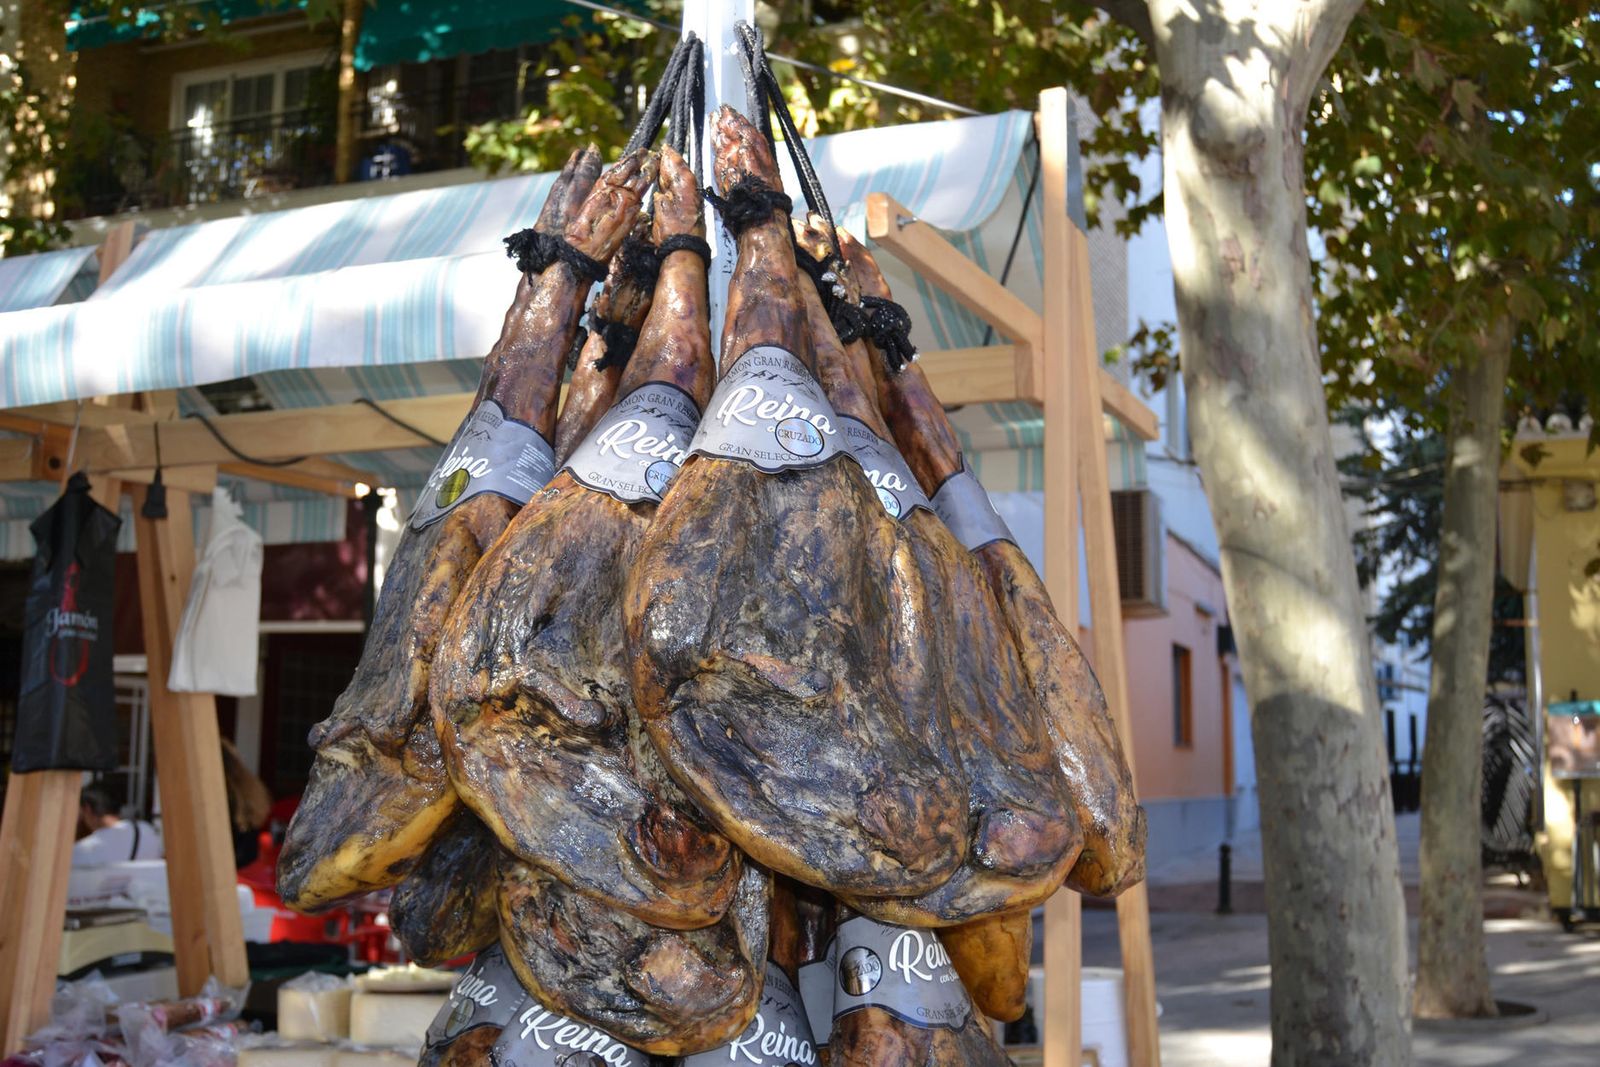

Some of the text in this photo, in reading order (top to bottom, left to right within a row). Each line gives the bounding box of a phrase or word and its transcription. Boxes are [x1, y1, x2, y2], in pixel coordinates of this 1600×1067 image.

[753, 356, 782, 368] GRAN
[648, 393, 675, 408] GRAN
[717, 384, 837, 435] Reina
[596, 420, 686, 468] Rein
[777, 428, 822, 446] CRUZADO
[718, 442, 752, 457] GRAN
[587, 471, 653, 495] GRAN SELEC
[729, 1012, 817, 1065] Reina
